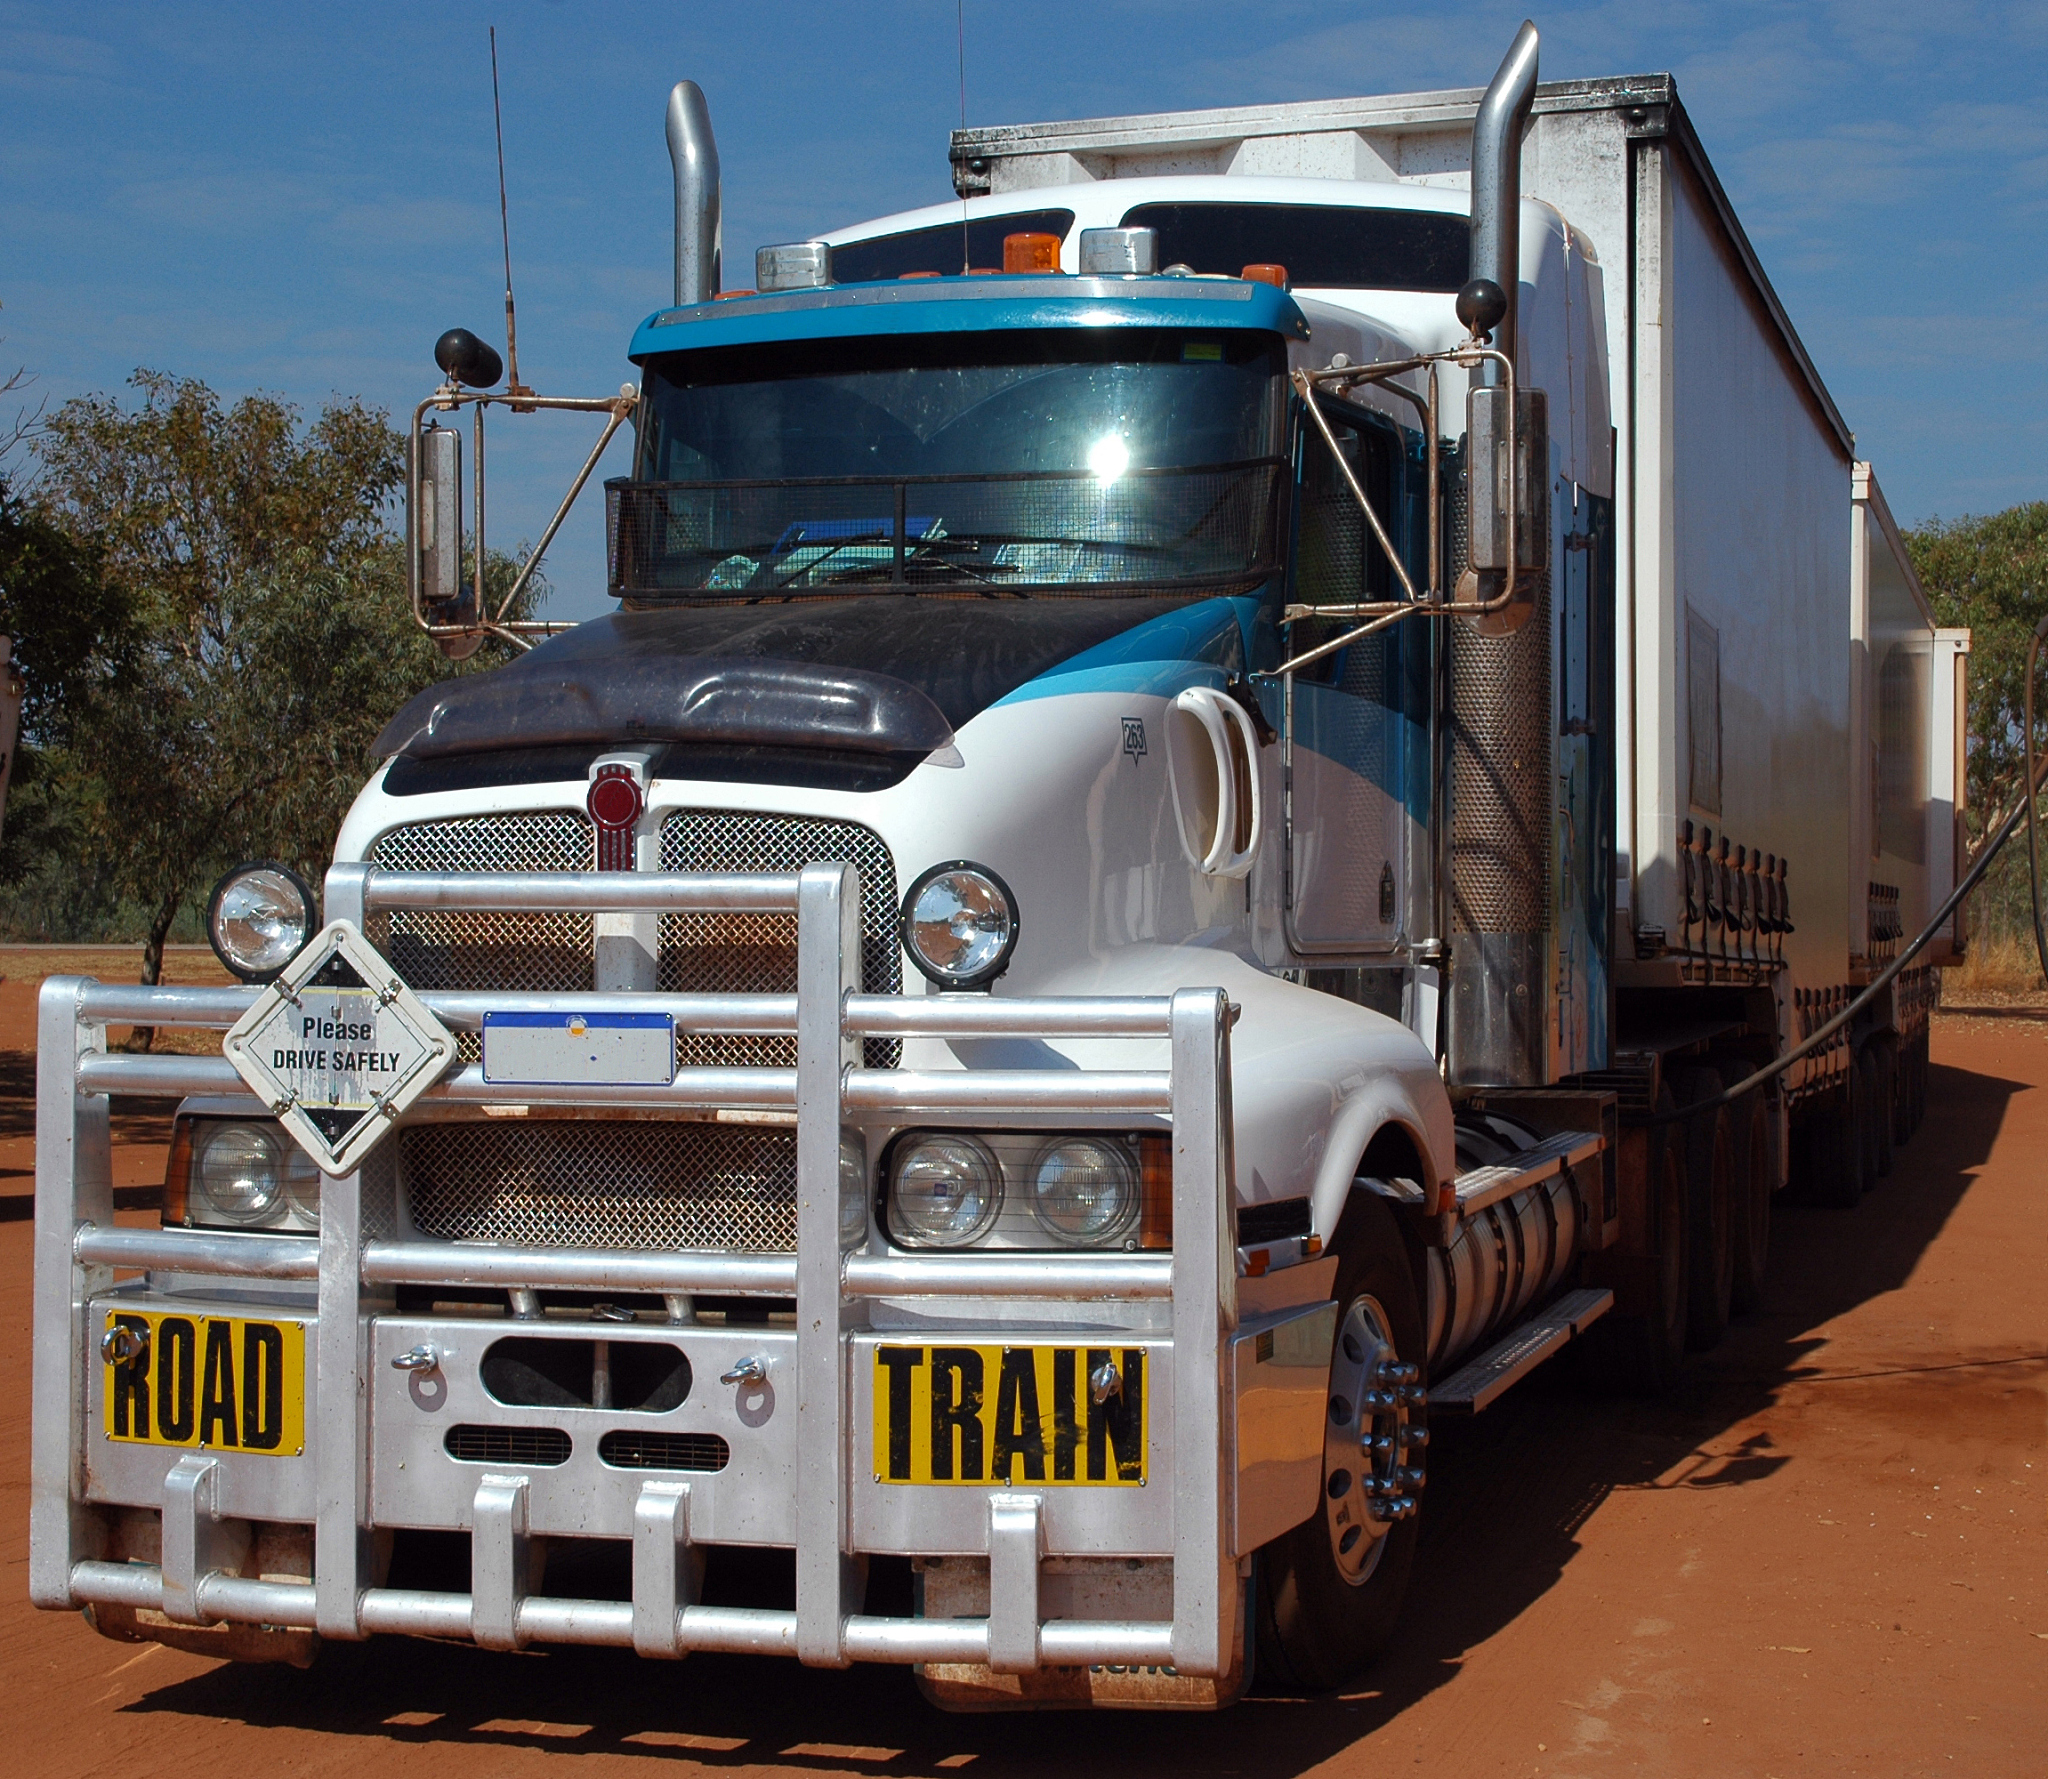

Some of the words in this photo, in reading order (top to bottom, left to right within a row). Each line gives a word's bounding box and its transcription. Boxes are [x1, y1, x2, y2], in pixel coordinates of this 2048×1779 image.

[1124, 724, 1144, 749] 263
[303, 1017, 372, 1041] Please
[273, 1050, 326, 1070] DRIVE
[332, 1051, 400, 1072] SAFELY
[113, 1314, 282, 1449] ROAD
[878, 1347, 1142, 1480] TRAIN
